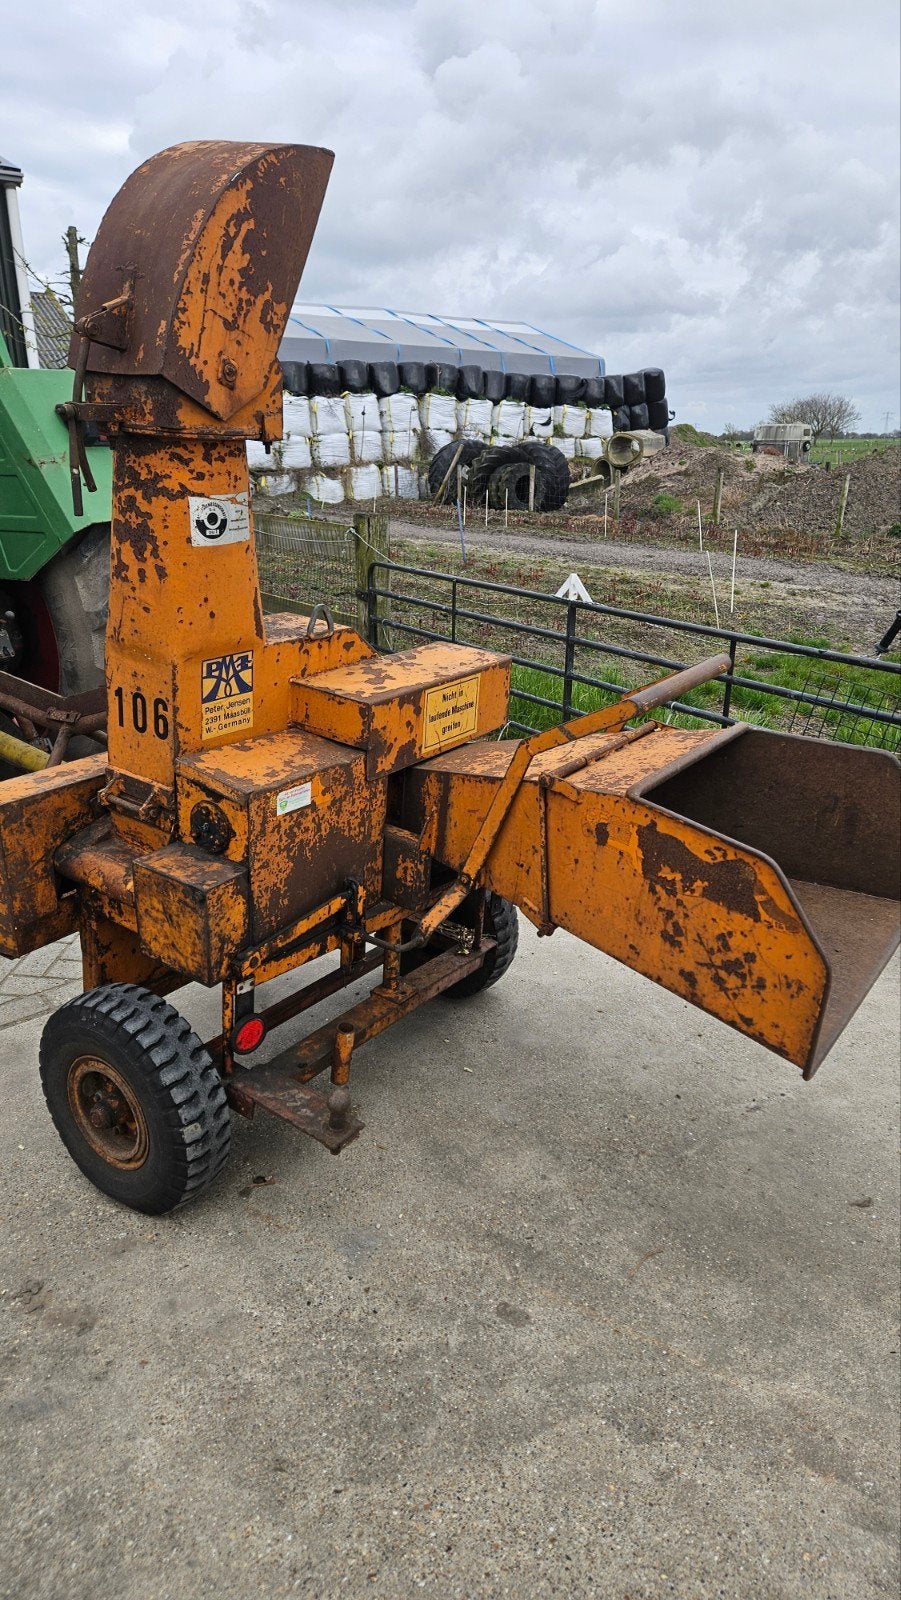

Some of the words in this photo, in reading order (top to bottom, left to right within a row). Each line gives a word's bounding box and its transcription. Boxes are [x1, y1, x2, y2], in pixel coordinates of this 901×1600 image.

[442, 690, 457, 703] Nicht
[459, 689, 463, 698] in
[226, 698, 250, 710] Jensen
[115, 686, 169, 740] 106
[429, 708, 451, 723] laufende
[452, 701, 474, 715] Maschine
[205, 716, 221, 725] 2391
[218, 717, 251, 731] Germany
[442, 721, 460, 736] greifen
